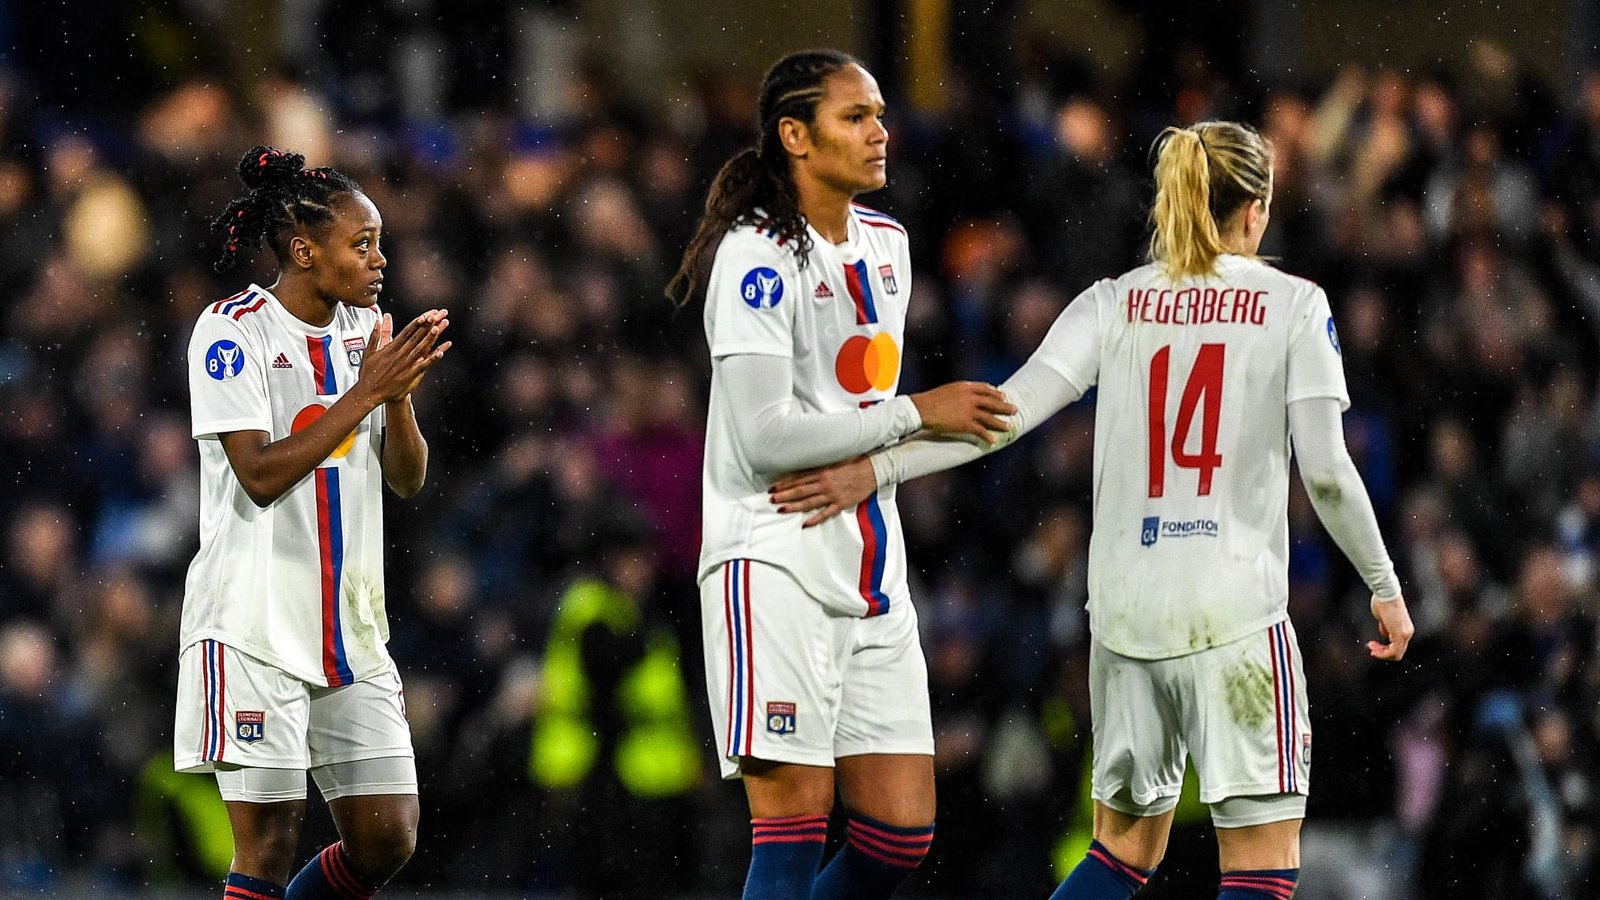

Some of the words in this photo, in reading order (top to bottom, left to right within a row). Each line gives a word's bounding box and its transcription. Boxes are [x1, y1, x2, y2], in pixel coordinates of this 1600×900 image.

[745, 283, 757, 300] 8
[1127, 287, 1269, 326] HEGERBERG
[209, 358, 218, 373] 8
[1148, 343, 1226, 498] 14
[239, 724, 261, 737] OL
[769, 715, 793, 731] OL
